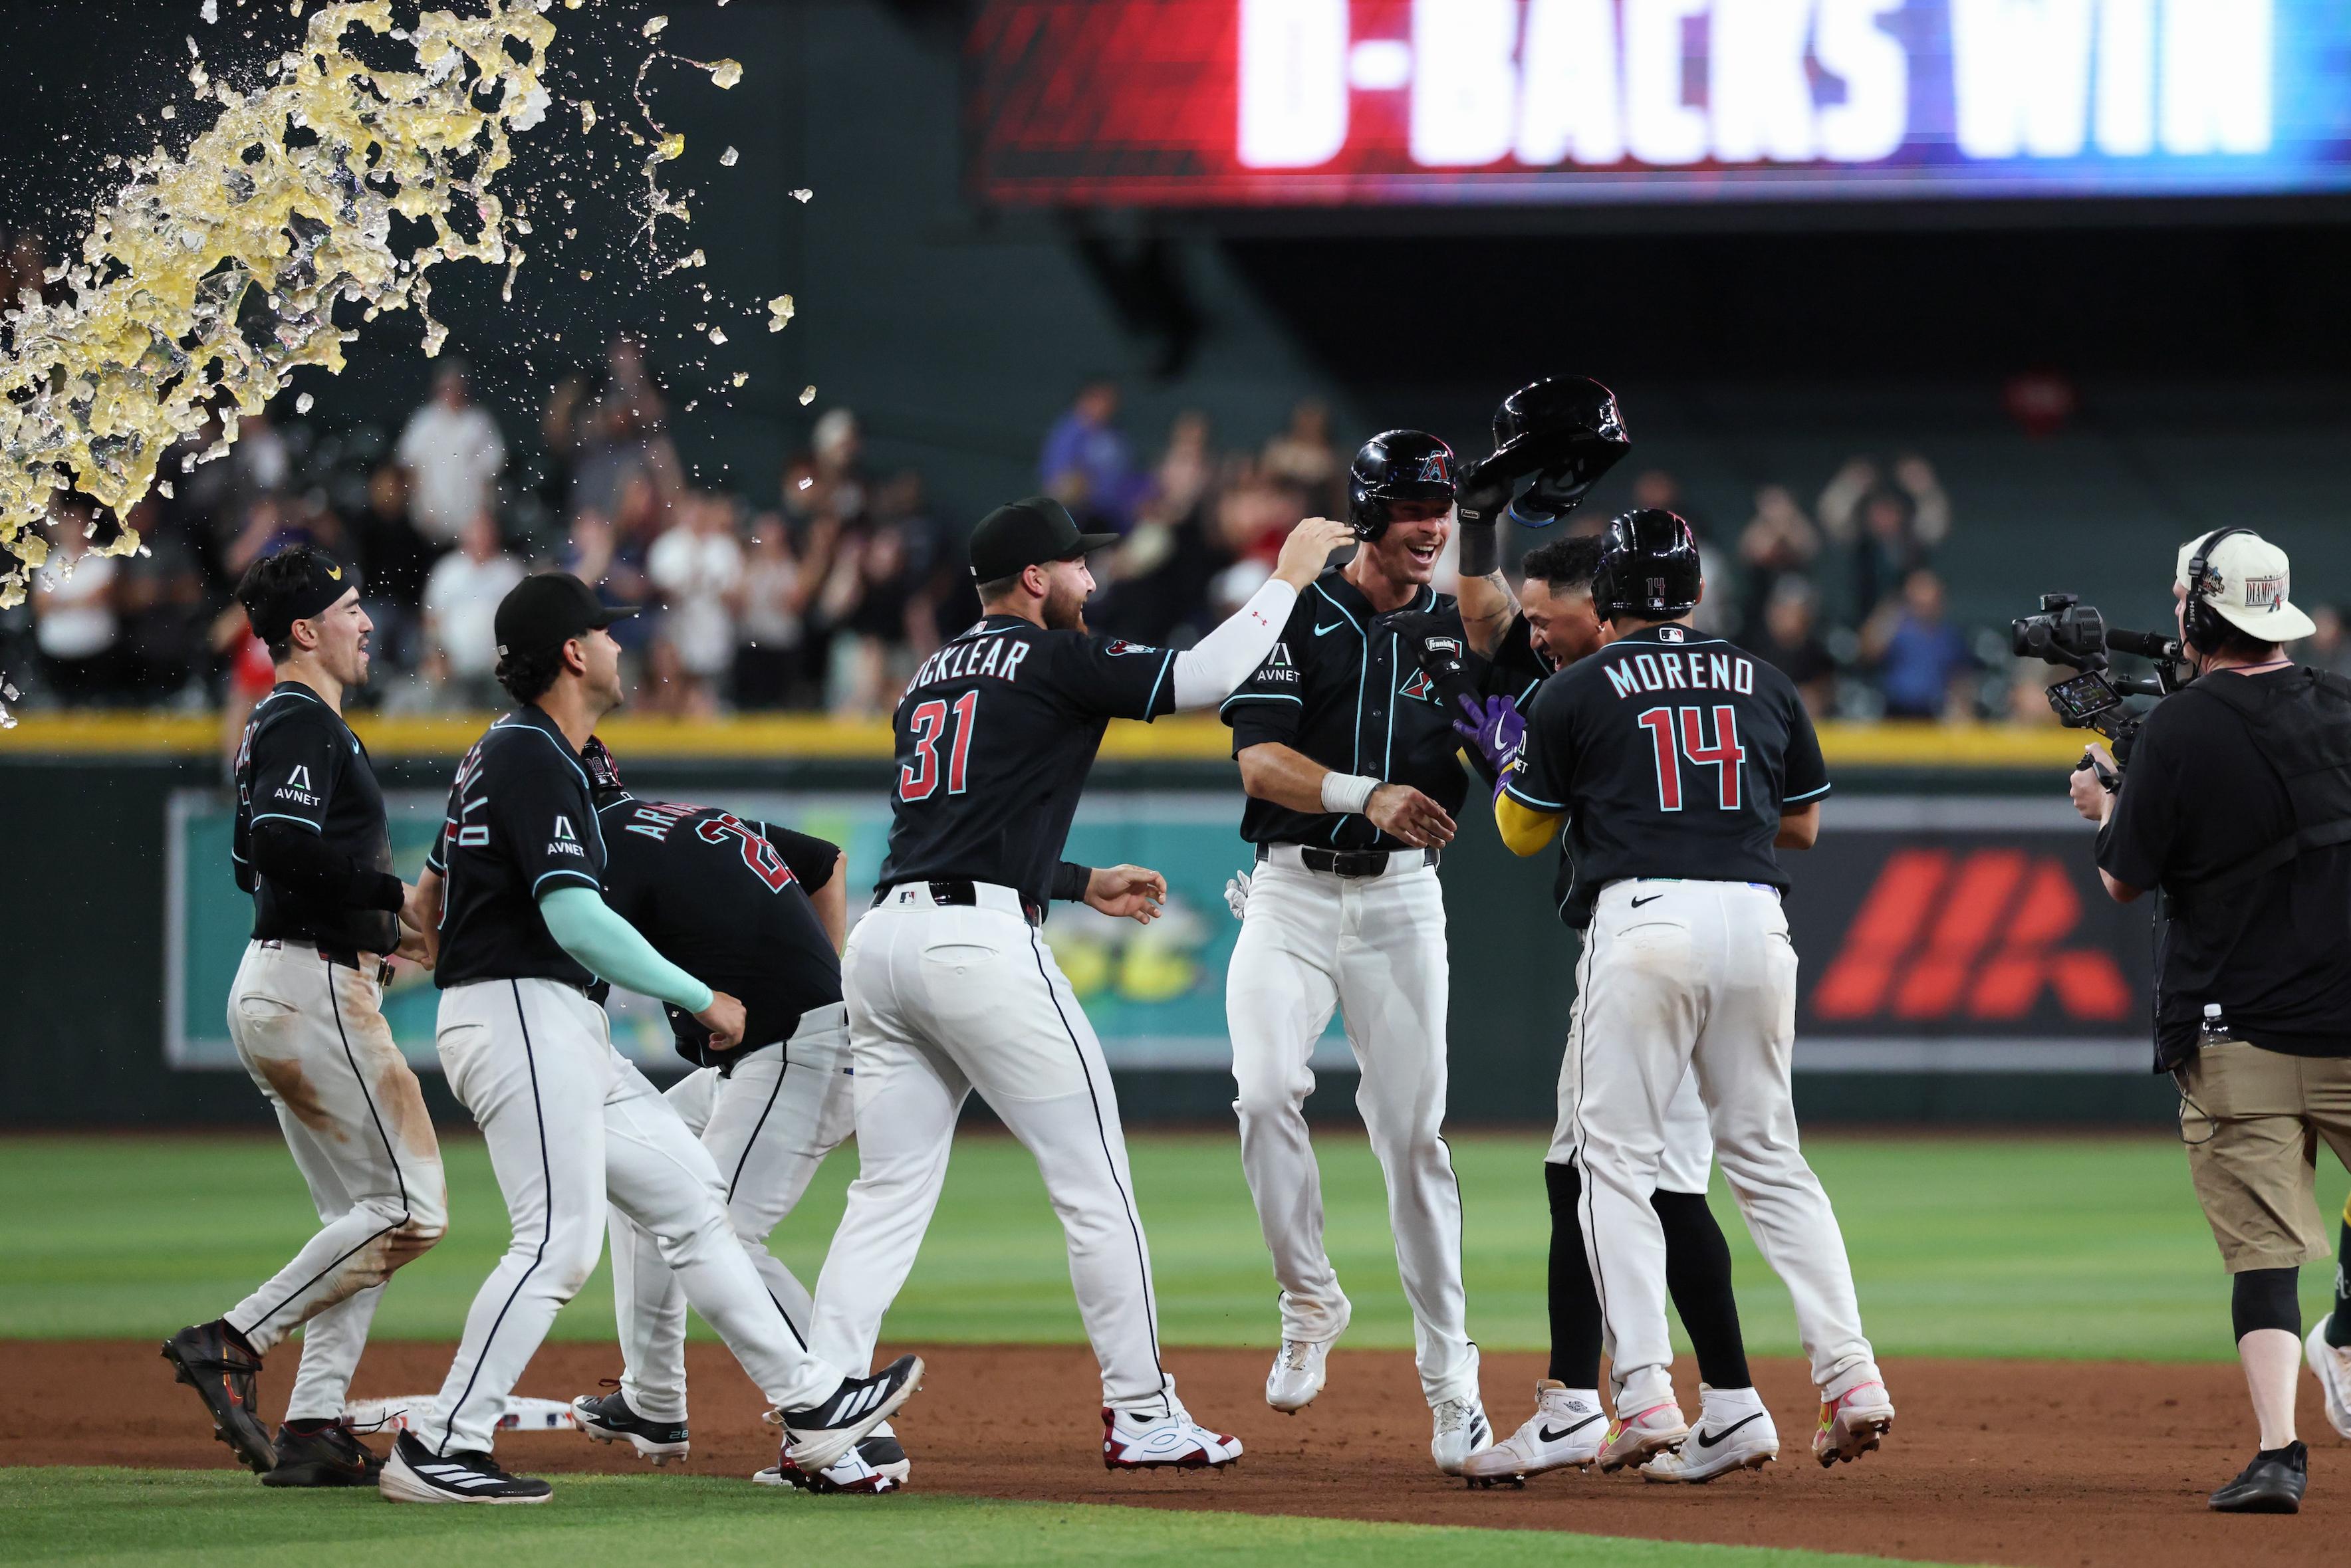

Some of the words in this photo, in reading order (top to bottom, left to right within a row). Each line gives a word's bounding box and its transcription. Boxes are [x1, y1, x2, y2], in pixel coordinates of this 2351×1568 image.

[1238, 0, 1908, 168] D-BACKS
[1949, 0, 2273, 158] WIN
[1646, 578, 1665, 596] 14
[1257, 670, 1300, 683] AVNET
[1602, 652, 1753, 699] MORENO
[899, 689, 979, 803] 31
[1514, 756, 1529, 774] NET
[1637, 705, 1746, 812] 14
[274, 788, 321, 806] AVNET
[547, 842, 585, 857] AVNET
